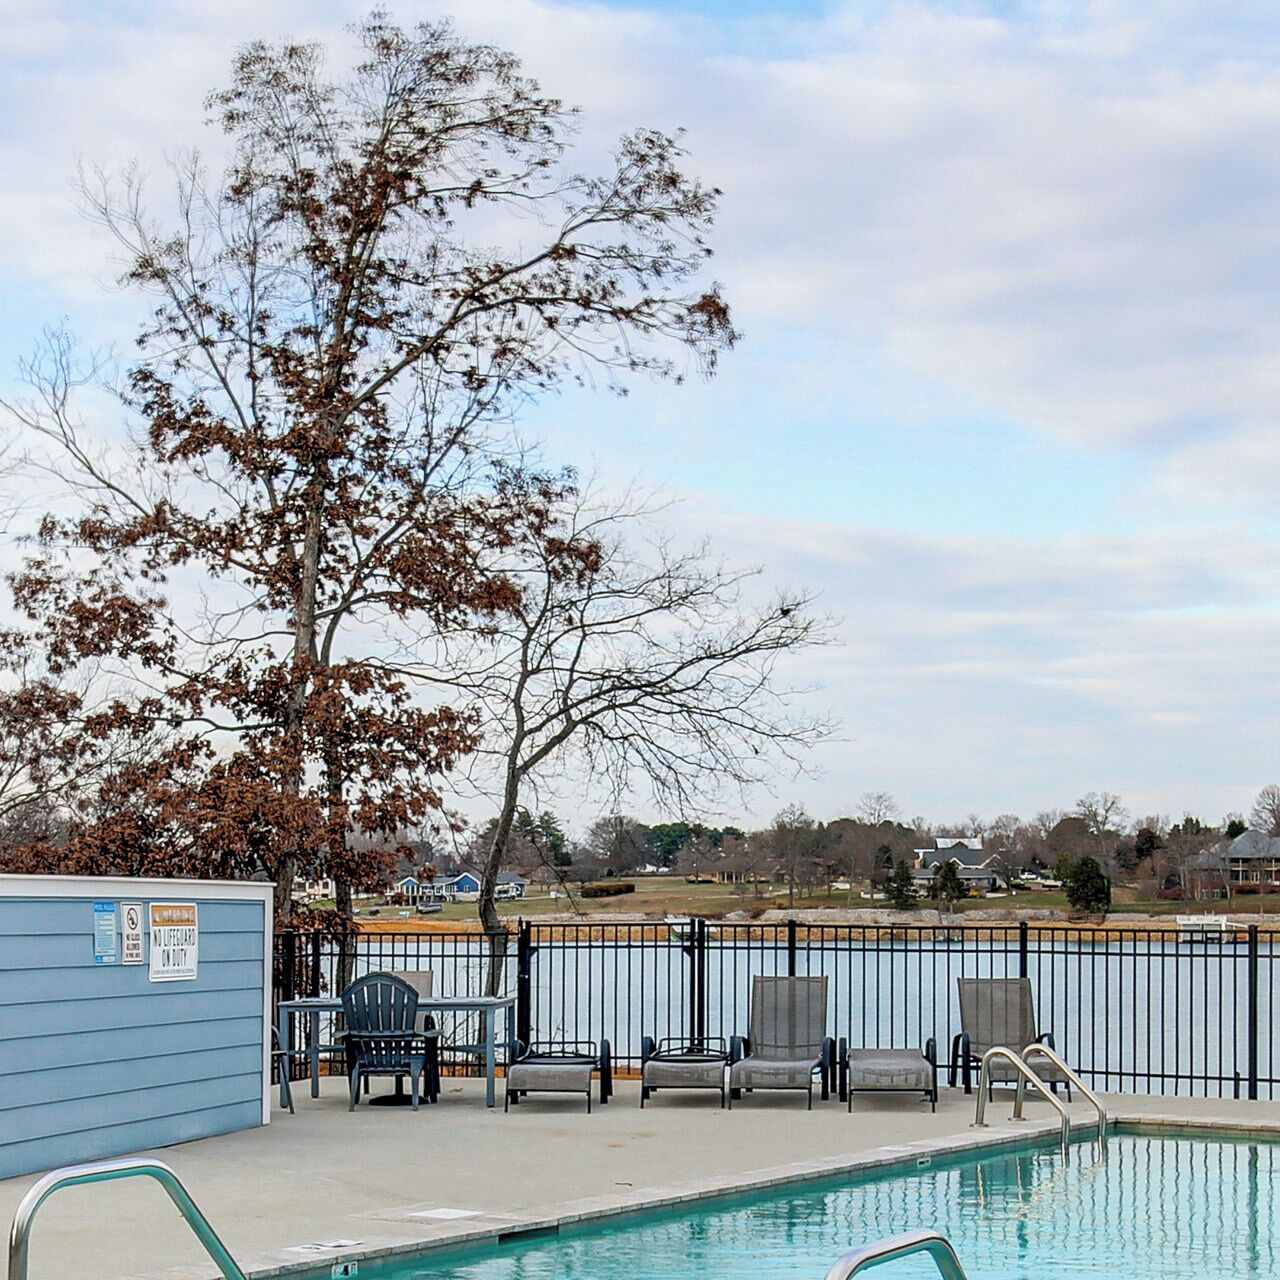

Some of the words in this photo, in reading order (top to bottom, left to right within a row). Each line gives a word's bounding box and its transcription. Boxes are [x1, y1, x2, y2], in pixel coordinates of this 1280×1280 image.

[154, 929, 162, 947] NO
[163, 928, 196, 947] LIFEGUARD
[162, 949, 170, 967] ON
[172, 948, 187, 967] DUTY
